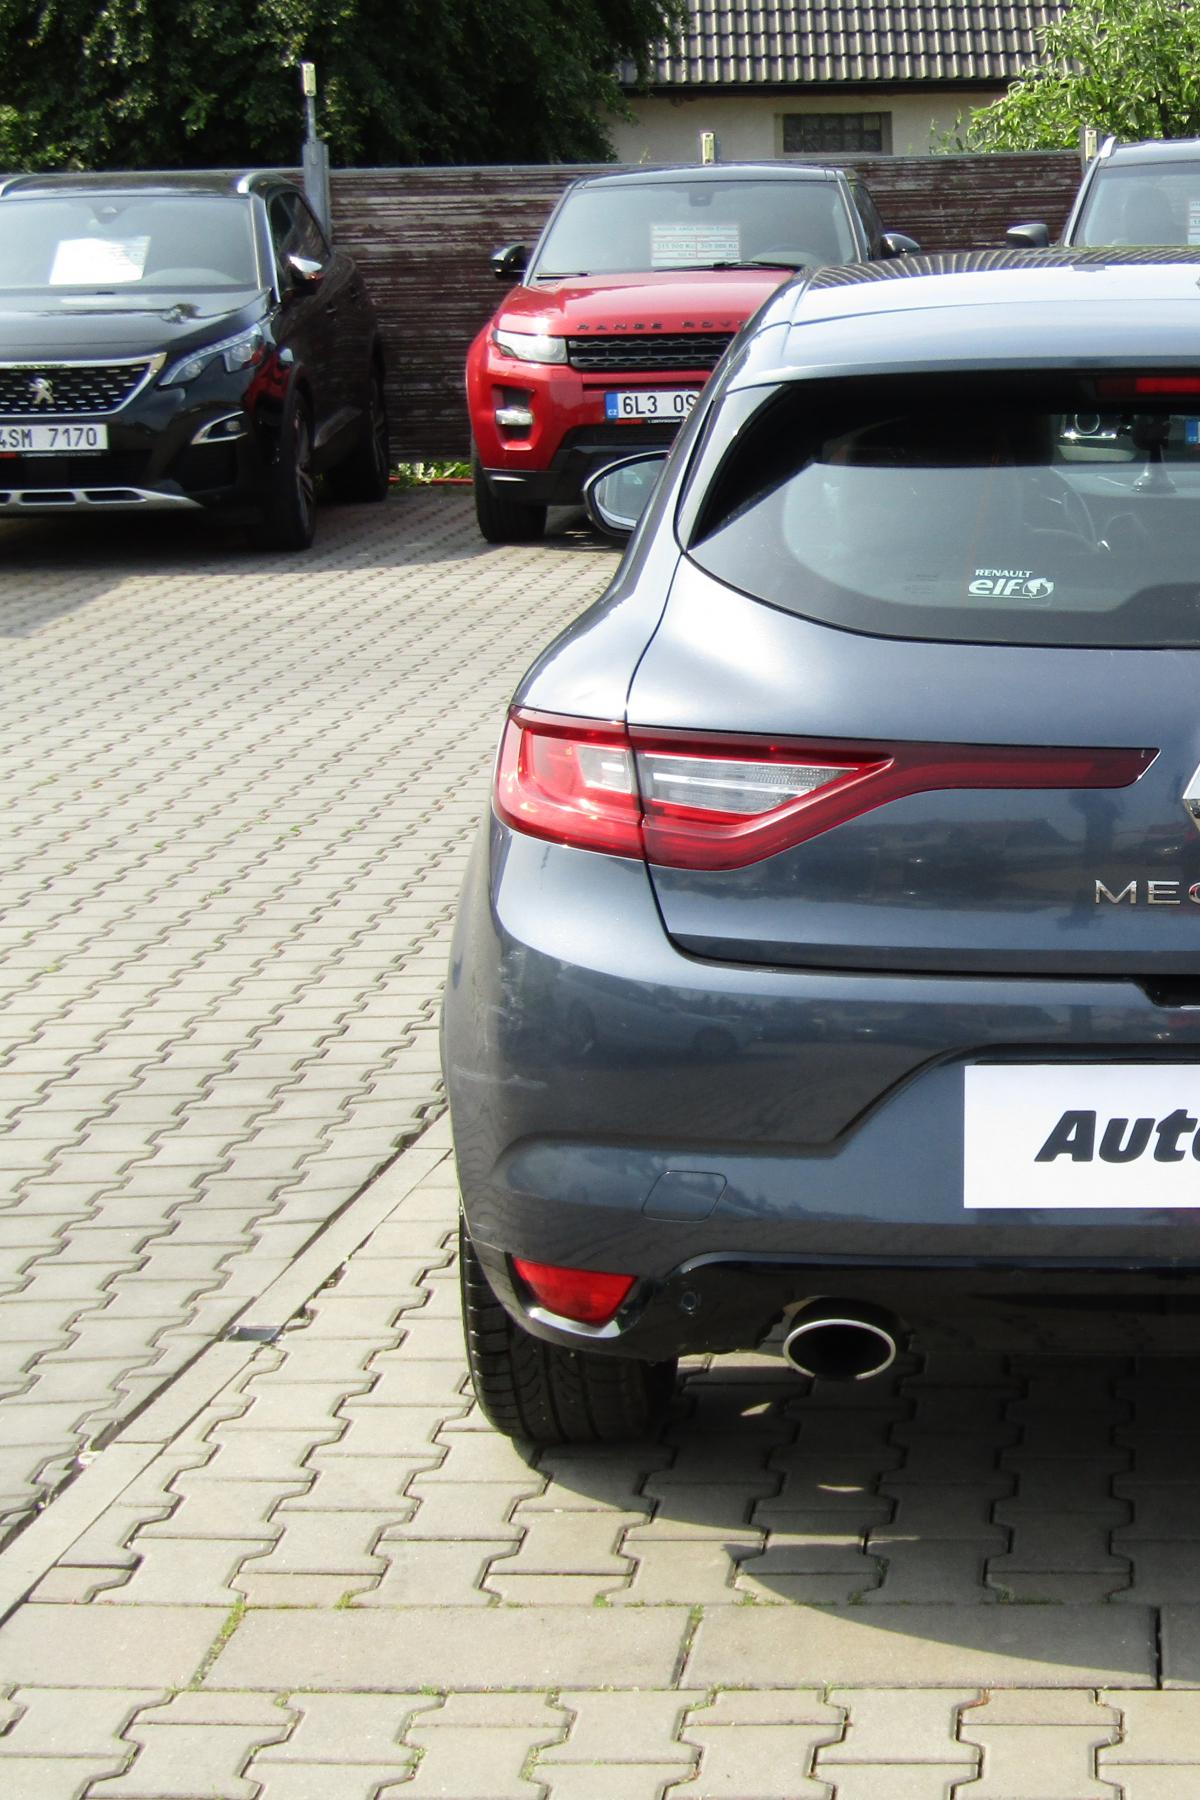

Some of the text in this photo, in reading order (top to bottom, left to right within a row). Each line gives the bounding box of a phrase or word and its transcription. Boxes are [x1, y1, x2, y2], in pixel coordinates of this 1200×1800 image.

[577, 323, 663, 331] RANGE
[623, 395, 658, 414] 6L3
[47, 427, 97, 447] 7170
[975, 569, 1033, 578] RENAULT
[968, 578, 1024, 595] elf
